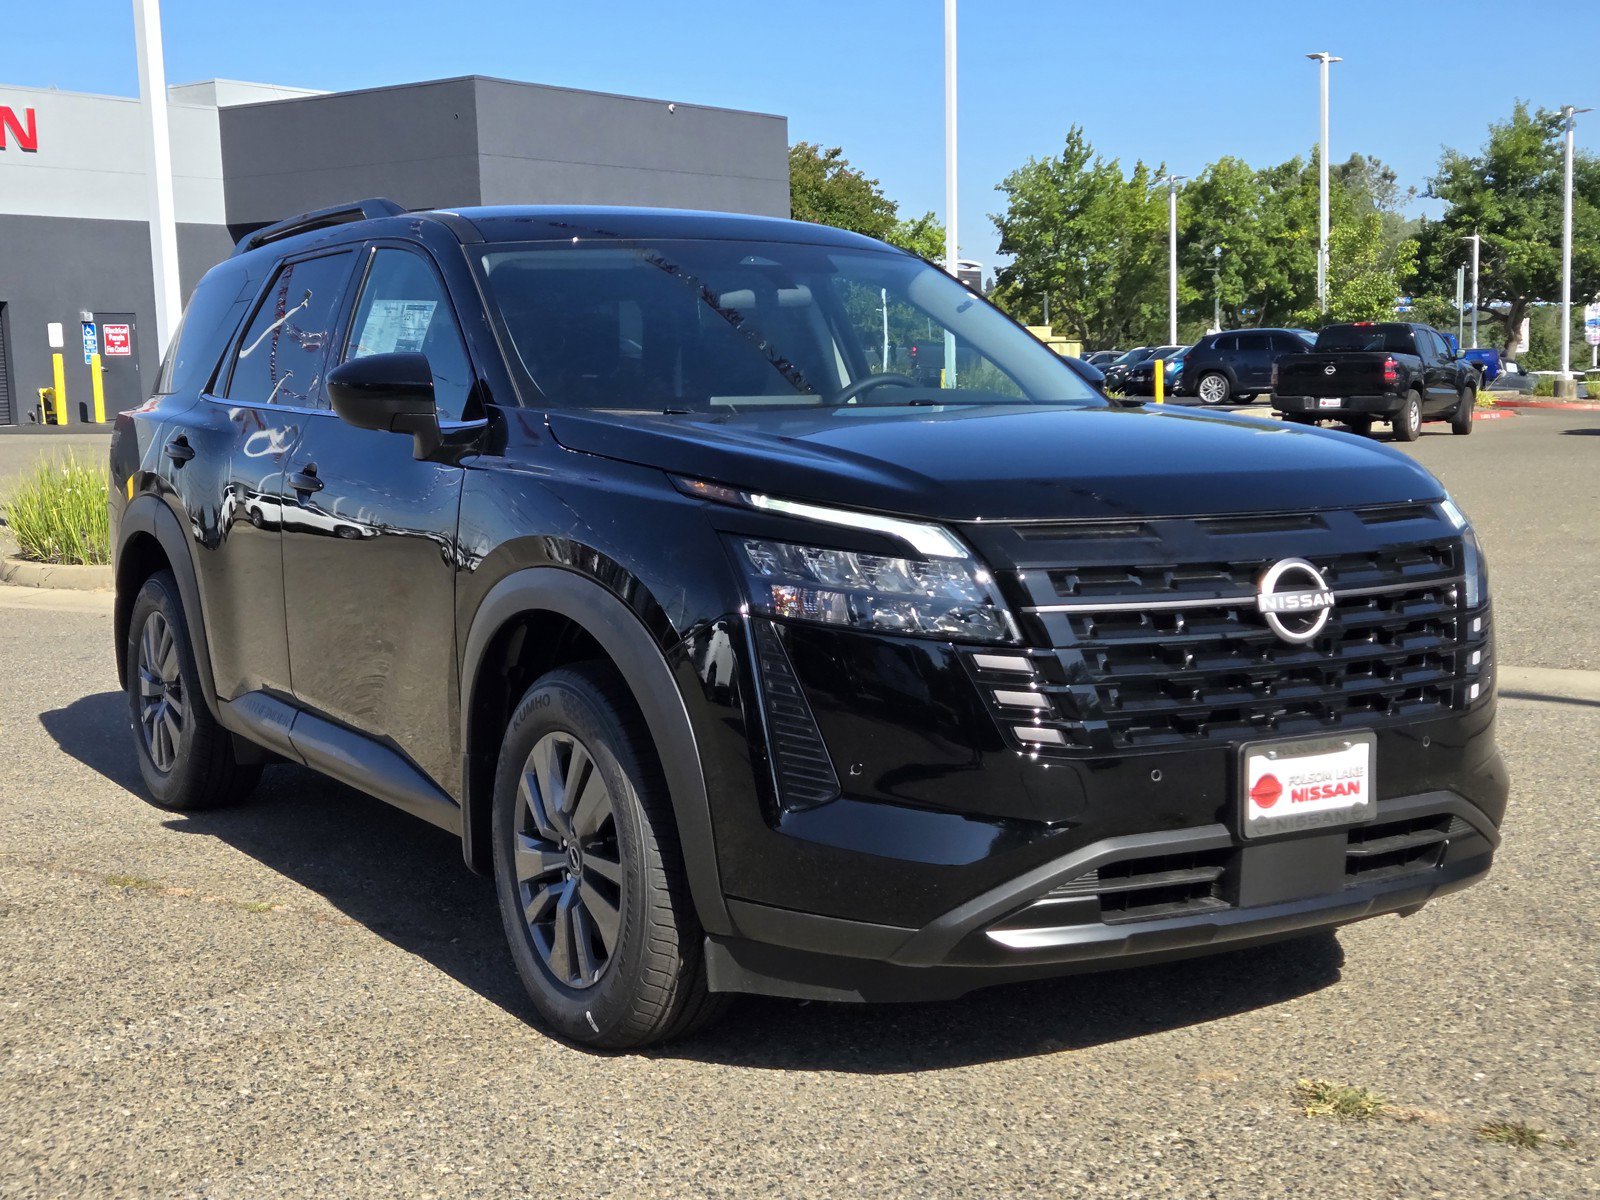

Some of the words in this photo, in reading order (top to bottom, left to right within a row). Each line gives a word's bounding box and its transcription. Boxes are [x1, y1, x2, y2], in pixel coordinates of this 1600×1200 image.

[0, 106, 37, 151] N
[1262, 592, 1335, 610] NISSAN
[513, 693, 551, 731] KUMHO
[1291, 780, 1361, 803] NISSAN
[1275, 809, 1348, 829] NISSAN
